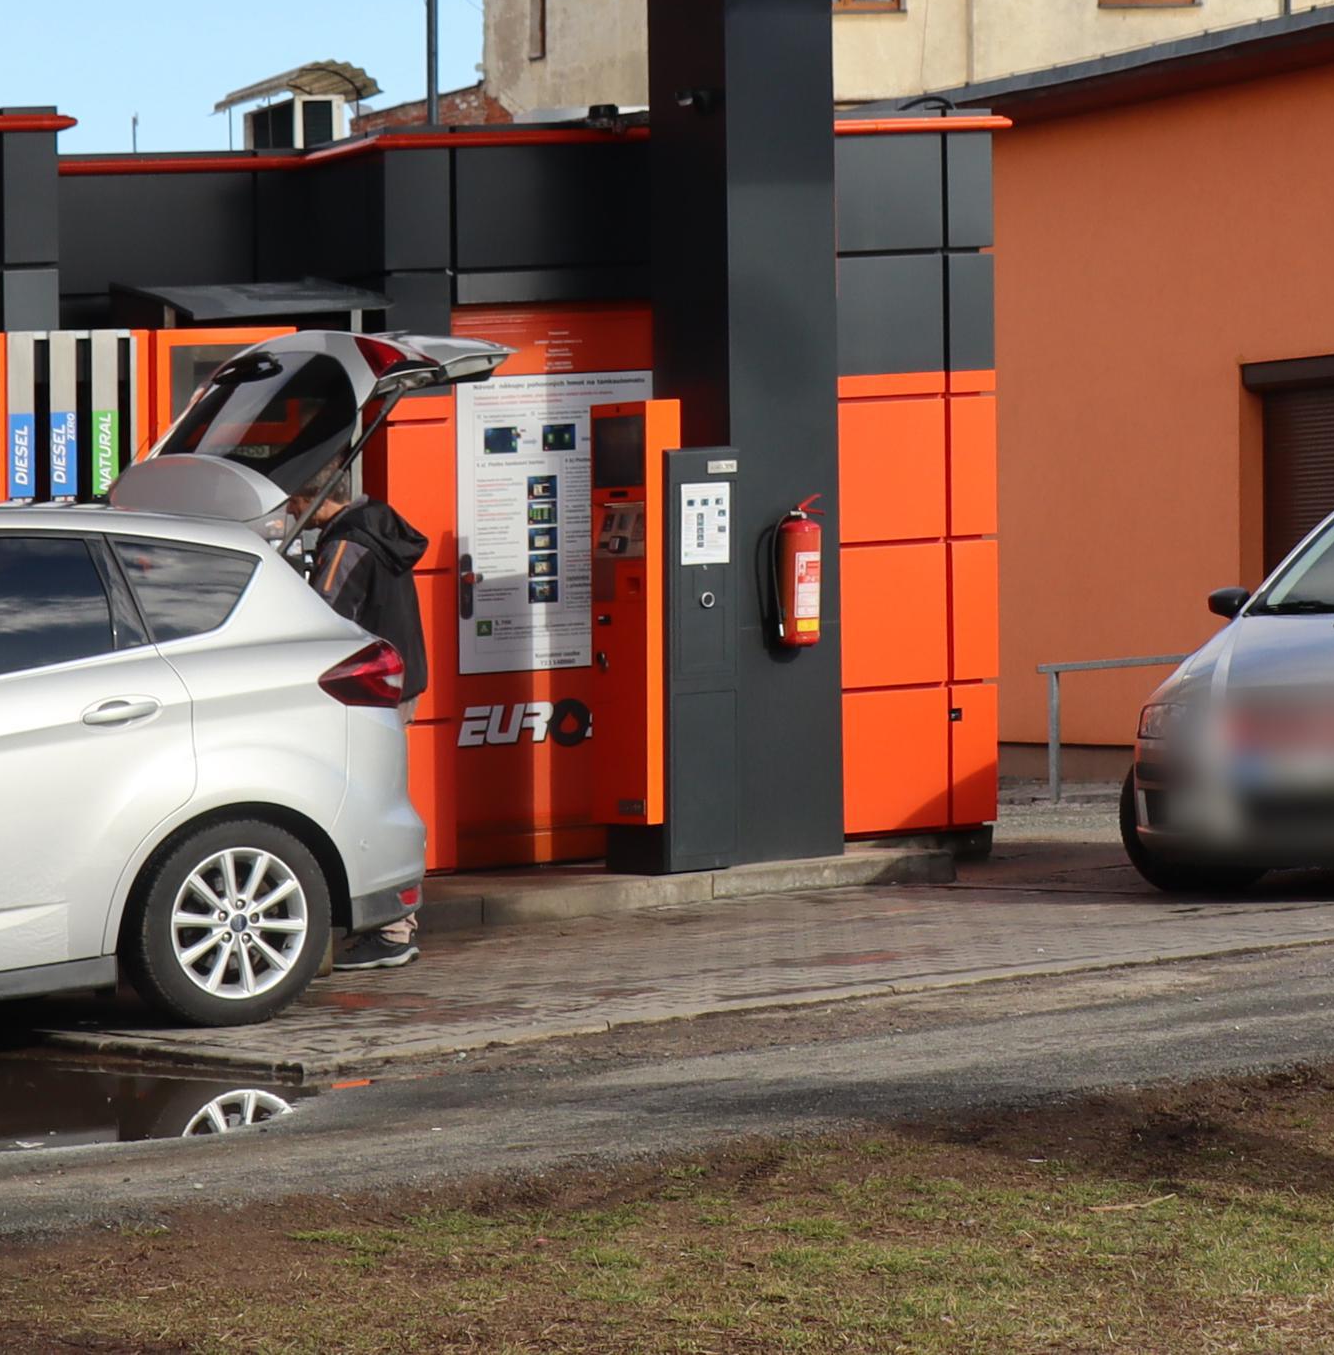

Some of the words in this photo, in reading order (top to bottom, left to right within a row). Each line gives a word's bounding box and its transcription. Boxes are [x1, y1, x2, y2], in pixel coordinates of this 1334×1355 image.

[14, 425, 28, 485] DIESEL
[52, 424, 66, 484] DIESEL
[67, 413, 76, 441] ZERO
[98, 413, 112, 491] NATURAL
